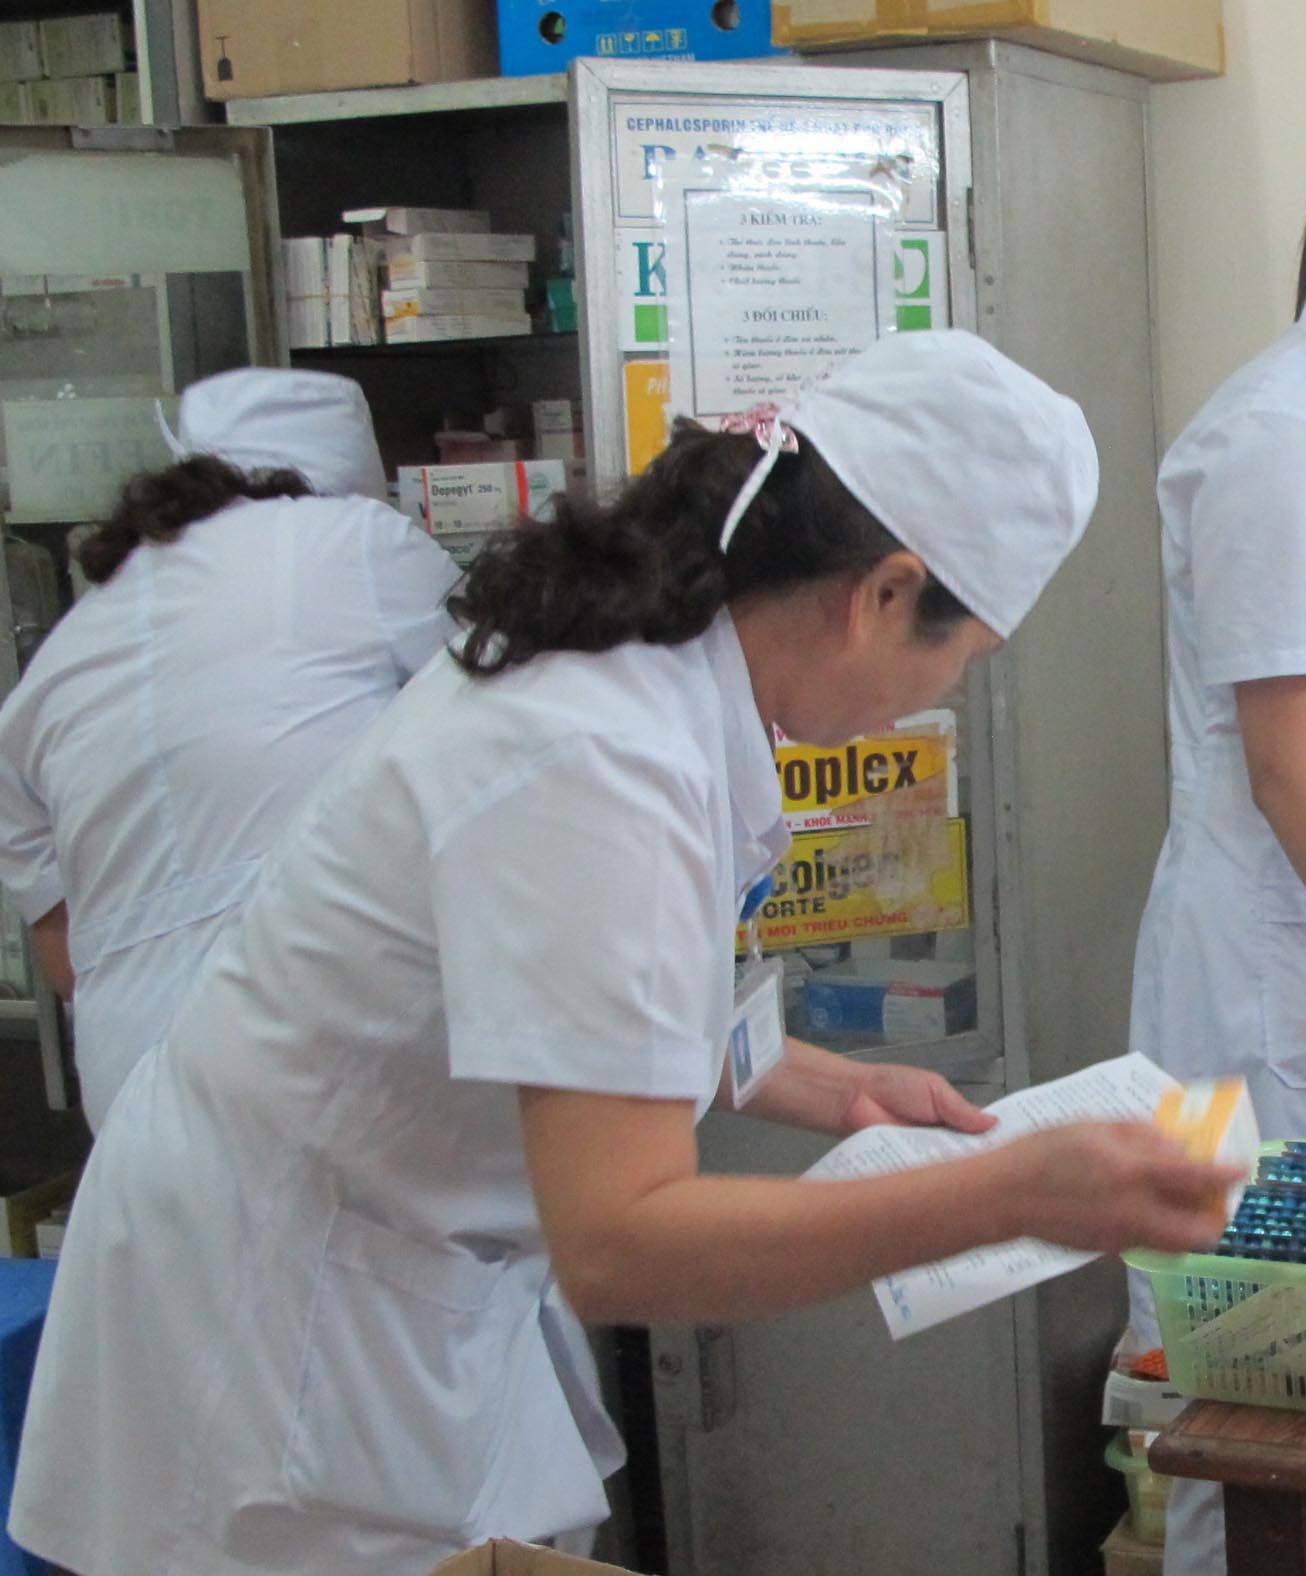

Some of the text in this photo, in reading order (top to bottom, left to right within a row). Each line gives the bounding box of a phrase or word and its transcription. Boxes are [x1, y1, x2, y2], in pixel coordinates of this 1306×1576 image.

[431, 484, 474, 499] Dopegyt
[776, 745, 919, 805] oplex
[757, 896, 826, 919] ORTE
